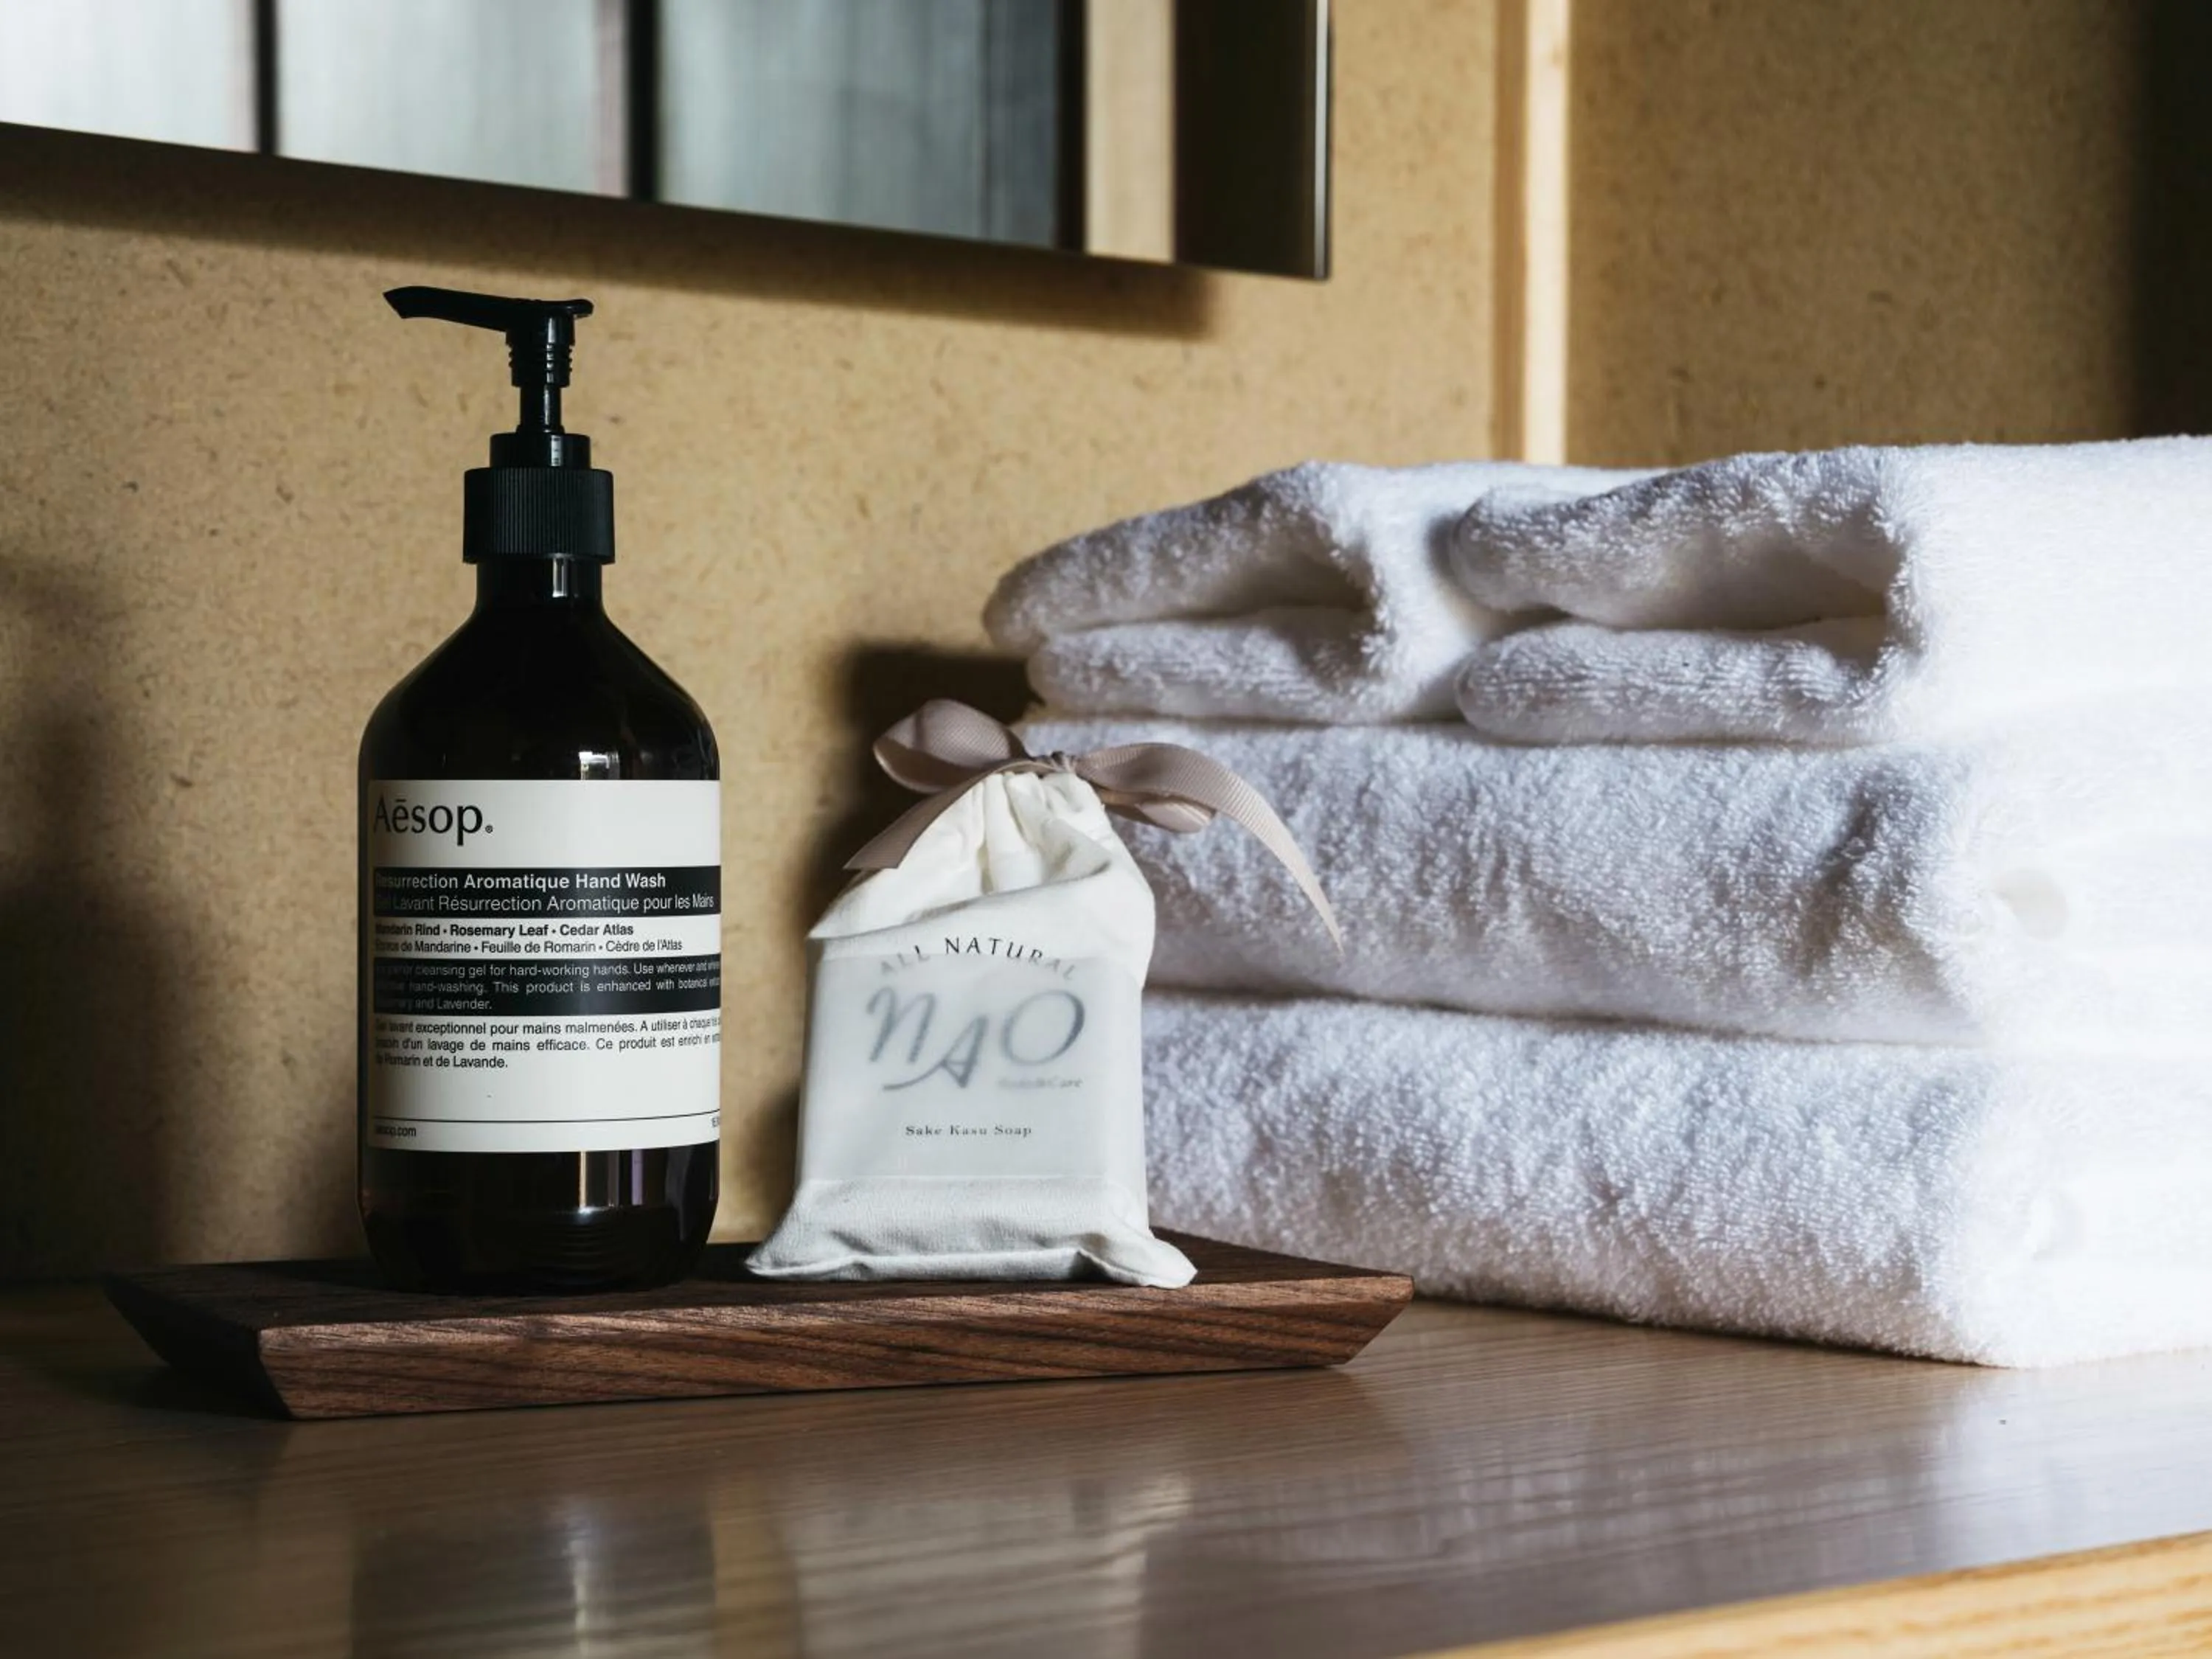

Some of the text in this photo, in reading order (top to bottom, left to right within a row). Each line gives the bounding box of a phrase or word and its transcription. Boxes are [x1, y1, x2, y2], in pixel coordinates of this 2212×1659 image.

[464, 874, 569, 892] Aromatique
[575, 874, 620, 888] Hand
[625, 873, 666, 888] Wash
[394, 897, 434, 911] Lavant
[439, 895, 542, 911] Résurrection
[546, 896, 639, 914] Aromatique
[644, 897, 672, 913] pour
[675, 894, 689, 908] les
[375, 924, 633, 939] darin Rind Rosemary Leaf Cedar Atlas
[415, 941, 471, 953] Mandarine
[481, 941, 521, 953] Feuille
[525, 942, 540, 953] de
[544, 940, 596, 953] Romarin
[605, 939, 639, 953] Cèdre
[642, 940, 655, 951] de
[944, 936, 1077, 981] NATURAL
[414, 964, 465, 978] cleansing
[468, 965, 487, 978] gel
[490, 964, 507, 975] for
[509, 964, 590, 978] hard-working
[594, 963, 629, 975] hands.
[633, 963, 654, 973] Use
[408, 981, 487, 995] hand-washing.
[493, 981, 519, 993] This
[526, 981, 574, 995] product
[580, 981, 591, 992] is
[597, 979, 651, 992] enhanced
[655, 978, 675, 990] with
[437, 998, 492, 1010] Lavender.
[415, 1022, 486, 1037] exceptionnel
[490, 1024, 519, 1037] pour
[523, 1023, 561, 1034] mains
[565, 1021, 638, 1034] malmenées.
[402, 1037, 422, 1050] d'un
[428, 1038, 465, 1053] lavage
[470, 1039, 486, 1051] de
[492, 1039, 530, 1051] mains
[536, 1038, 591, 1051] efficace.
[596, 1037, 613, 1049] Ce
[619, 1034, 657, 1052] produit
[660, 1036, 675, 1048] est
[422, 1055, 433, 1068] et
[436, 1056, 450, 1068] de
[453, 1055, 508, 1068] Lavande.
[376, 1126, 417, 1138] op.com
[905, 1125, 1032, 1138] Sake Kasu Soap
